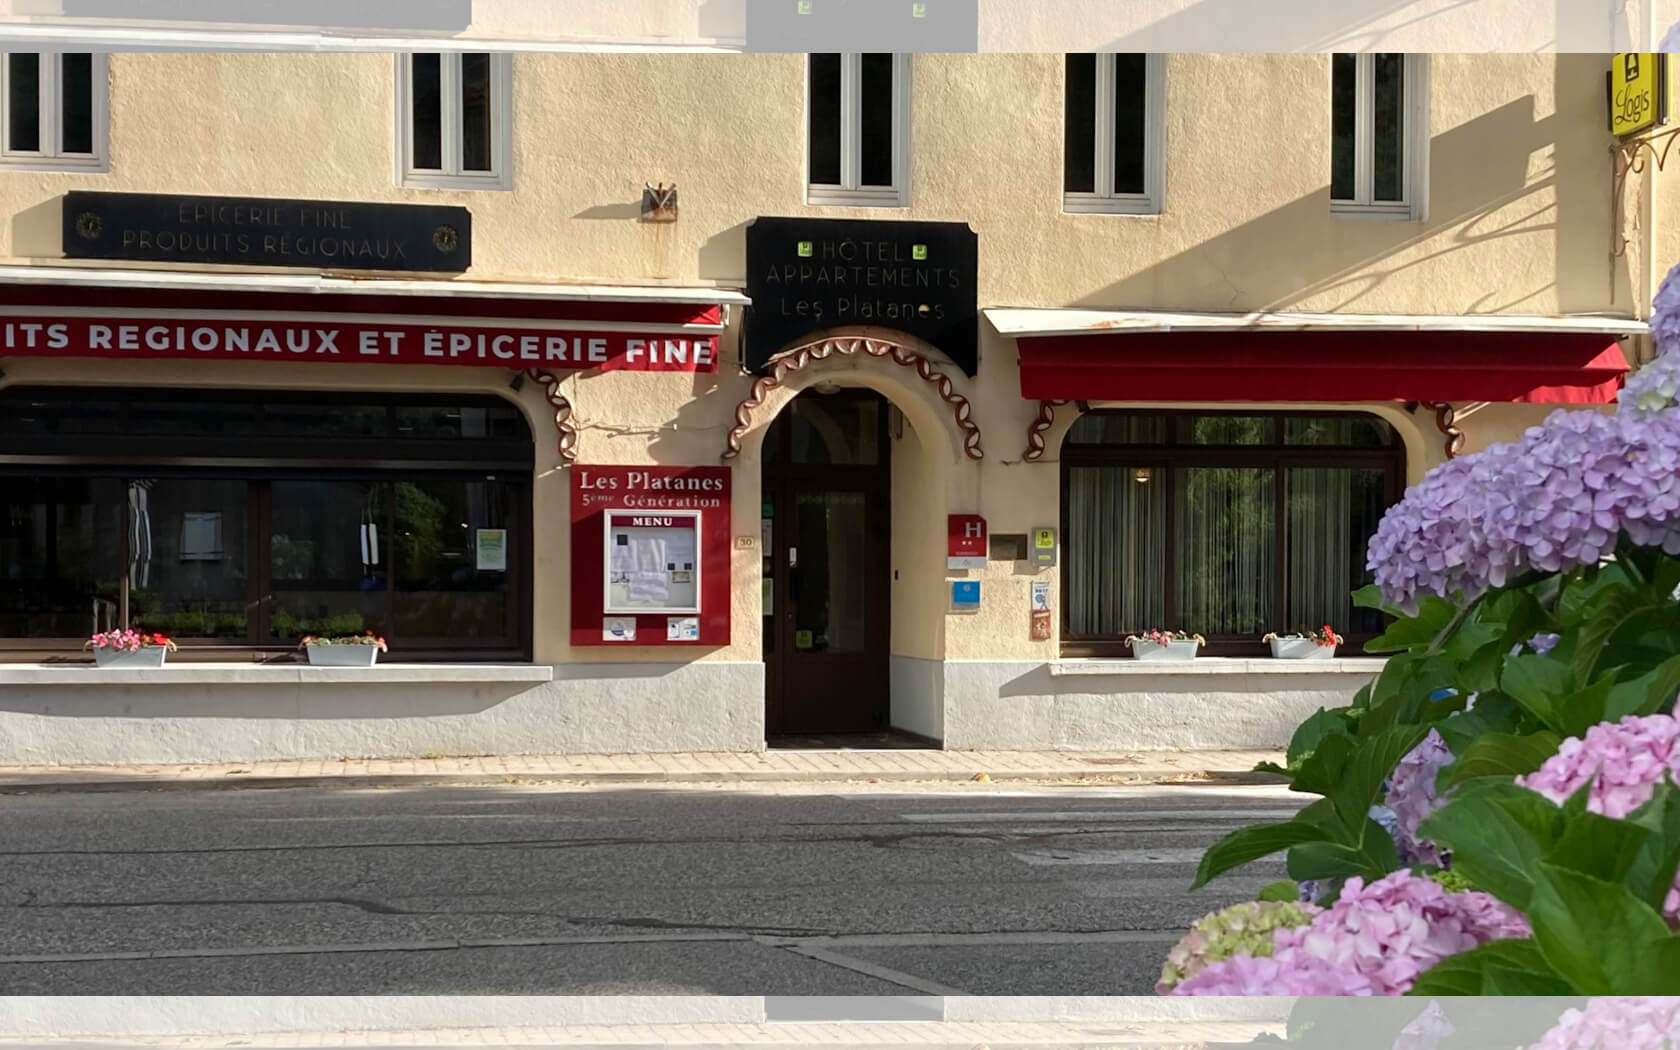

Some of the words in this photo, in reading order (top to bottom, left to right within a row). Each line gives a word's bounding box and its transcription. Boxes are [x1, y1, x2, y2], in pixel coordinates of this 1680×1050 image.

[1615, 84, 1650, 126] Logis
[300, 207, 353, 229] FINE
[122, 229, 249, 254] PRODUITS
[766, 263, 961, 288] APPARTEMENTS
[780, 296, 824, 319] Les
[838, 293, 945, 320] Platanes
[5, 323, 69, 349] ITS
[89, 325, 341, 354] REGIONAUX
[359, 330, 405, 356] ET
[424, 329, 608, 362] ÉPICERIE
[625, 338, 713, 365] FINE
[580, 471, 618, 489] Les
[626, 471, 723, 491] Platanes
[623, 494, 720, 508] Génération
[632, 517, 673, 527] MENU
[965, 521, 982, 538] H
